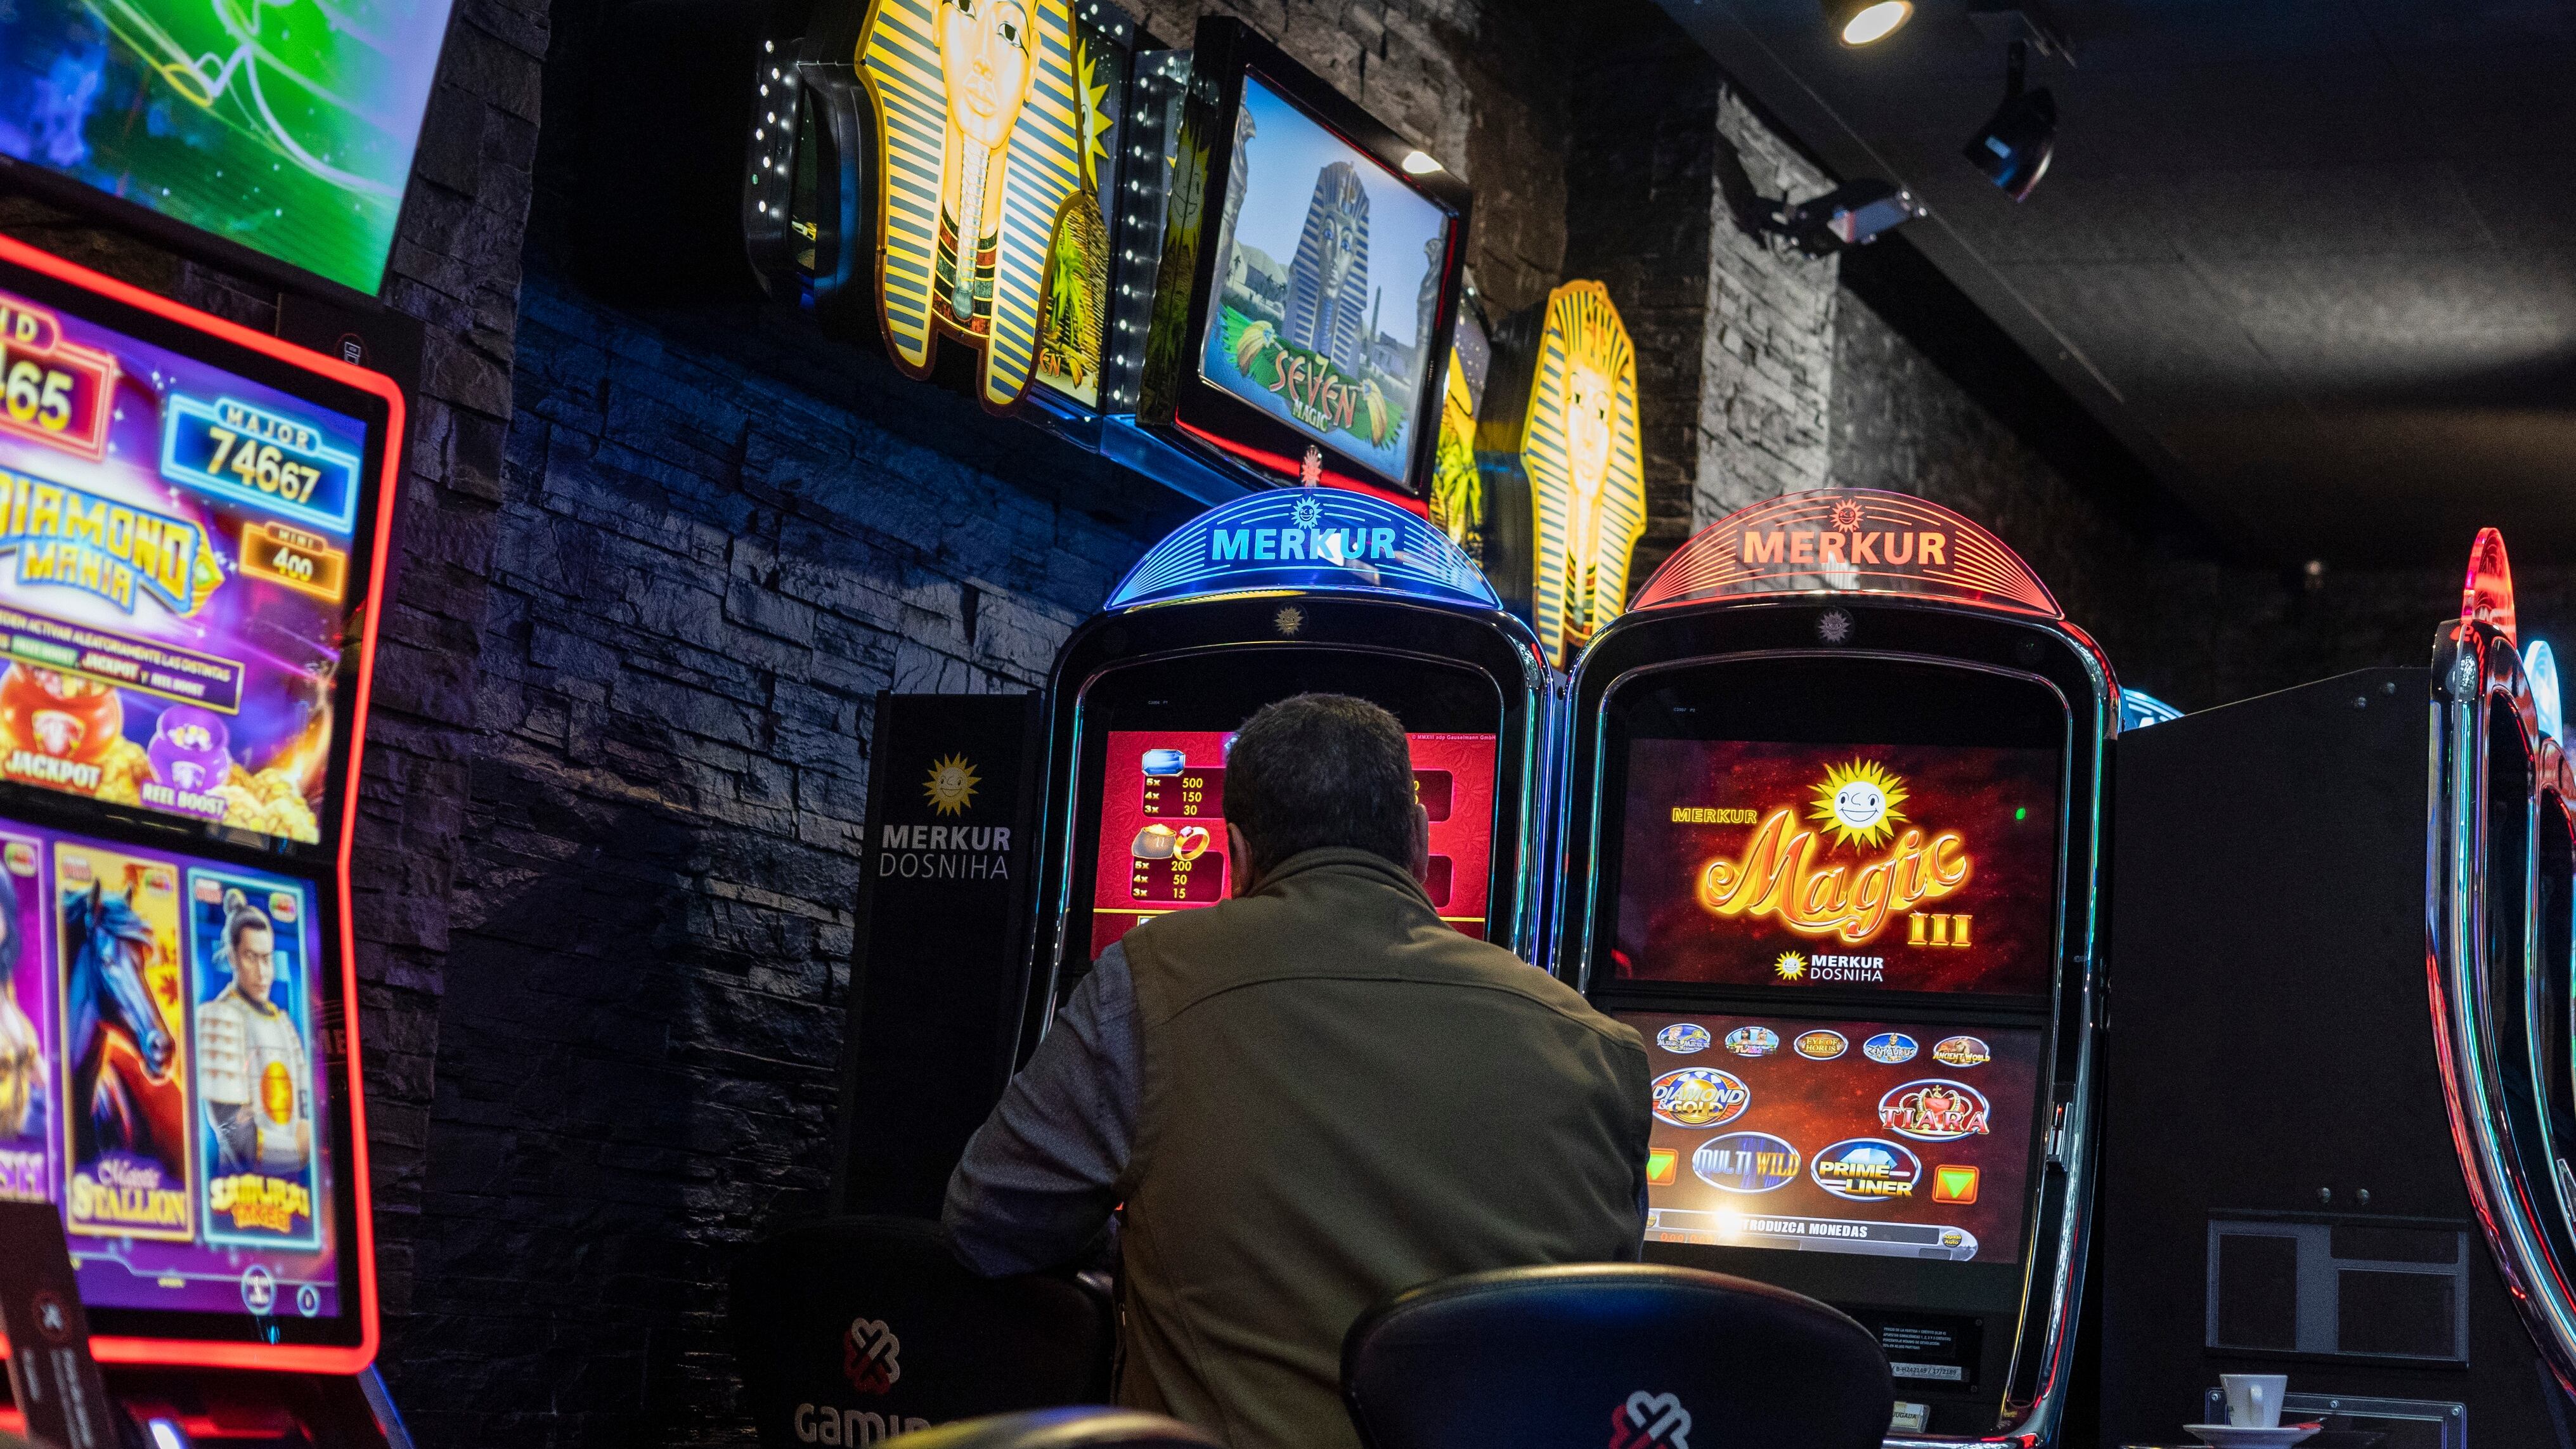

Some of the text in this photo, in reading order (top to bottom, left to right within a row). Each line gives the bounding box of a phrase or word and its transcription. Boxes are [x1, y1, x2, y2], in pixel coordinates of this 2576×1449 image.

[0, 341, 74, 432] 65
[1269, 350, 1357, 429] SEVEN
[226, 406, 309, 450] MAJOR
[1293, 400, 1329, 432] MAGIC
[207, 426, 321, 503] 74667
[278, 528, 315, 549] MINI
[1212, 528, 1397, 560] MERKUR
[1743, 530, 1947, 566] MERKUR
[24, 542, 132, 606] MANIA
[273, 547, 313, 582] 400
[4, 749, 101, 790] JACKPOT
[1146, 777, 1203, 788] 5x 500
[142, 782, 226, 815] REEL BOOST
[1144, 791, 1202, 802] 4x 150
[1144, 805, 1198, 815] 3x 30
[1673, 807, 1757, 824] MERKUR
[882, 824, 1011, 851] MERKUR
[879, 853, 1009, 880] DOSNIHA
[1133, 874, 1188, 885] 4x 50
[1135, 861, 1192, 871] 5x 200
[1705, 809, 1967, 942] Magic
[1133, 888, 1186, 899] 3x 15
[1908, 913, 1973, 947] III
[1810, 967, 1884, 982] DOSNIHA
[1811, 954, 1884, 969] MERKUR
[1652, 1085, 1745, 1104] DIAMOND
[1880, 1107, 1990, 1134] TIARA
[1695, 1148, 1800, 1178] MULTI WILD
[1819, 1161, 1891, 1179] PRIME
[72, 1173, 187, 1225] STALLION
[1845, 1179, 1913, 1197] LINER
[1743, 1218, 1868, 1237] TRODUZCA MONEDAS
